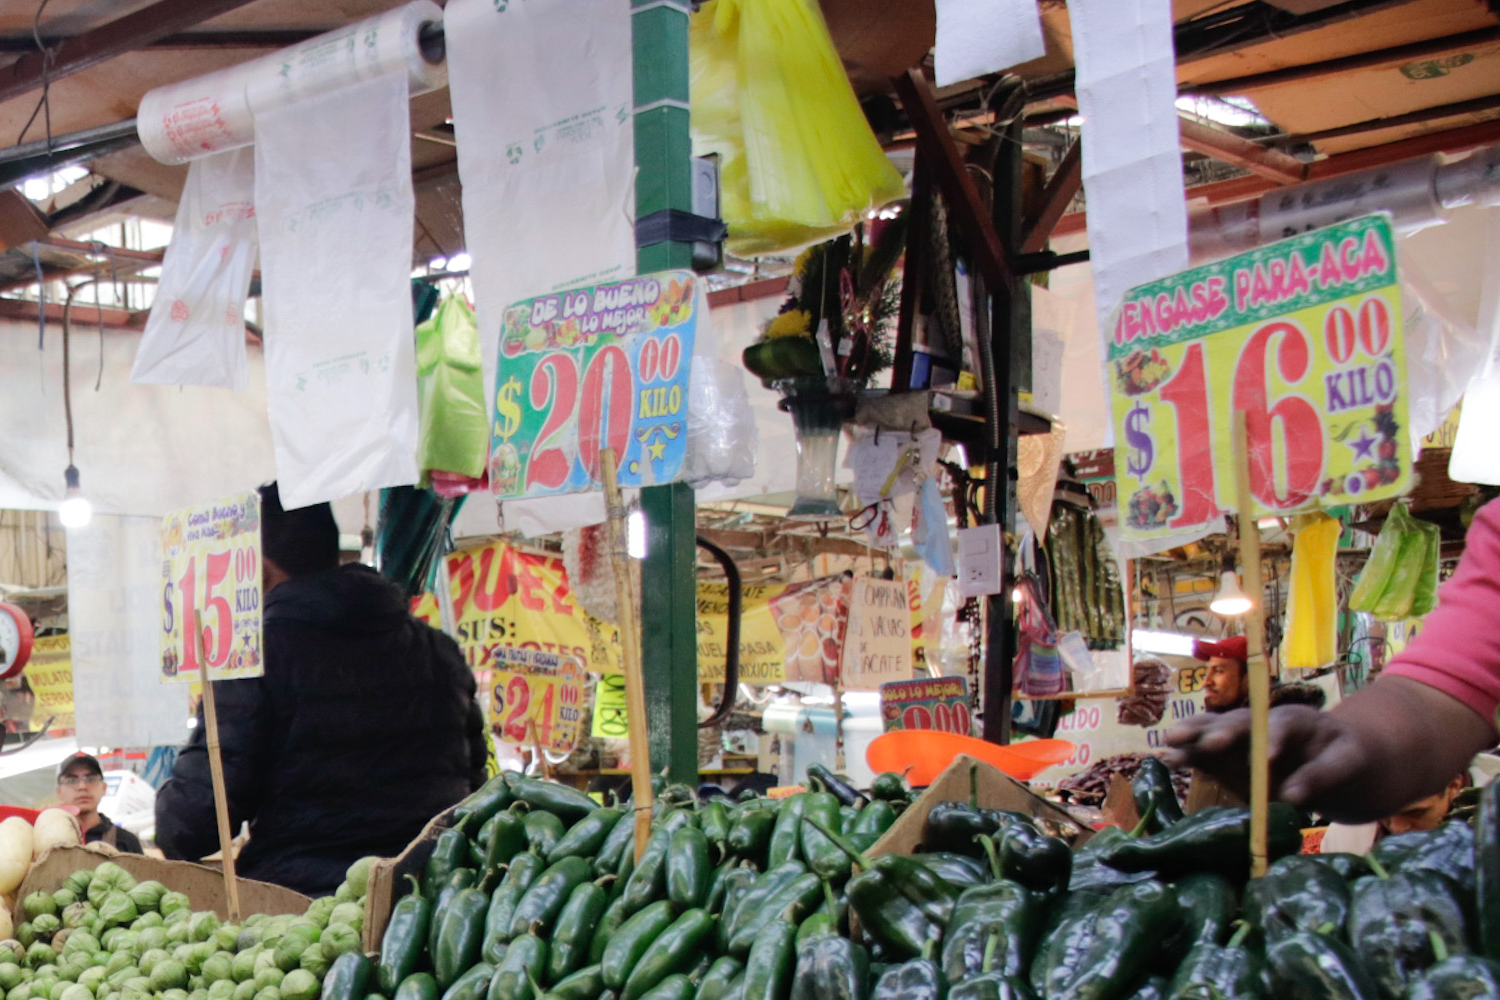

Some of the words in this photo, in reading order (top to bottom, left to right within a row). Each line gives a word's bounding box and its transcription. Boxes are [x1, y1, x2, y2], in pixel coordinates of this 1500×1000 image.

[531, 298, 557, 326] DE
[563, 292, 587, 317] LO
[593, 279, 660, 313] BUENO
[582, 314, 598, 333] LO
[602, 307, 645, 336] MEJOR
[1325, 298, 1389, 364] 00
[639, 334, 681, 384] 00
[639, 385, 681, 419] KILO
[1325, 361, 1395, 412] KILO
[235, 586, 259, 613] KILO
[559, 705, 579, 722] KILO
[1055, 706, 1100, 731] LIDO
